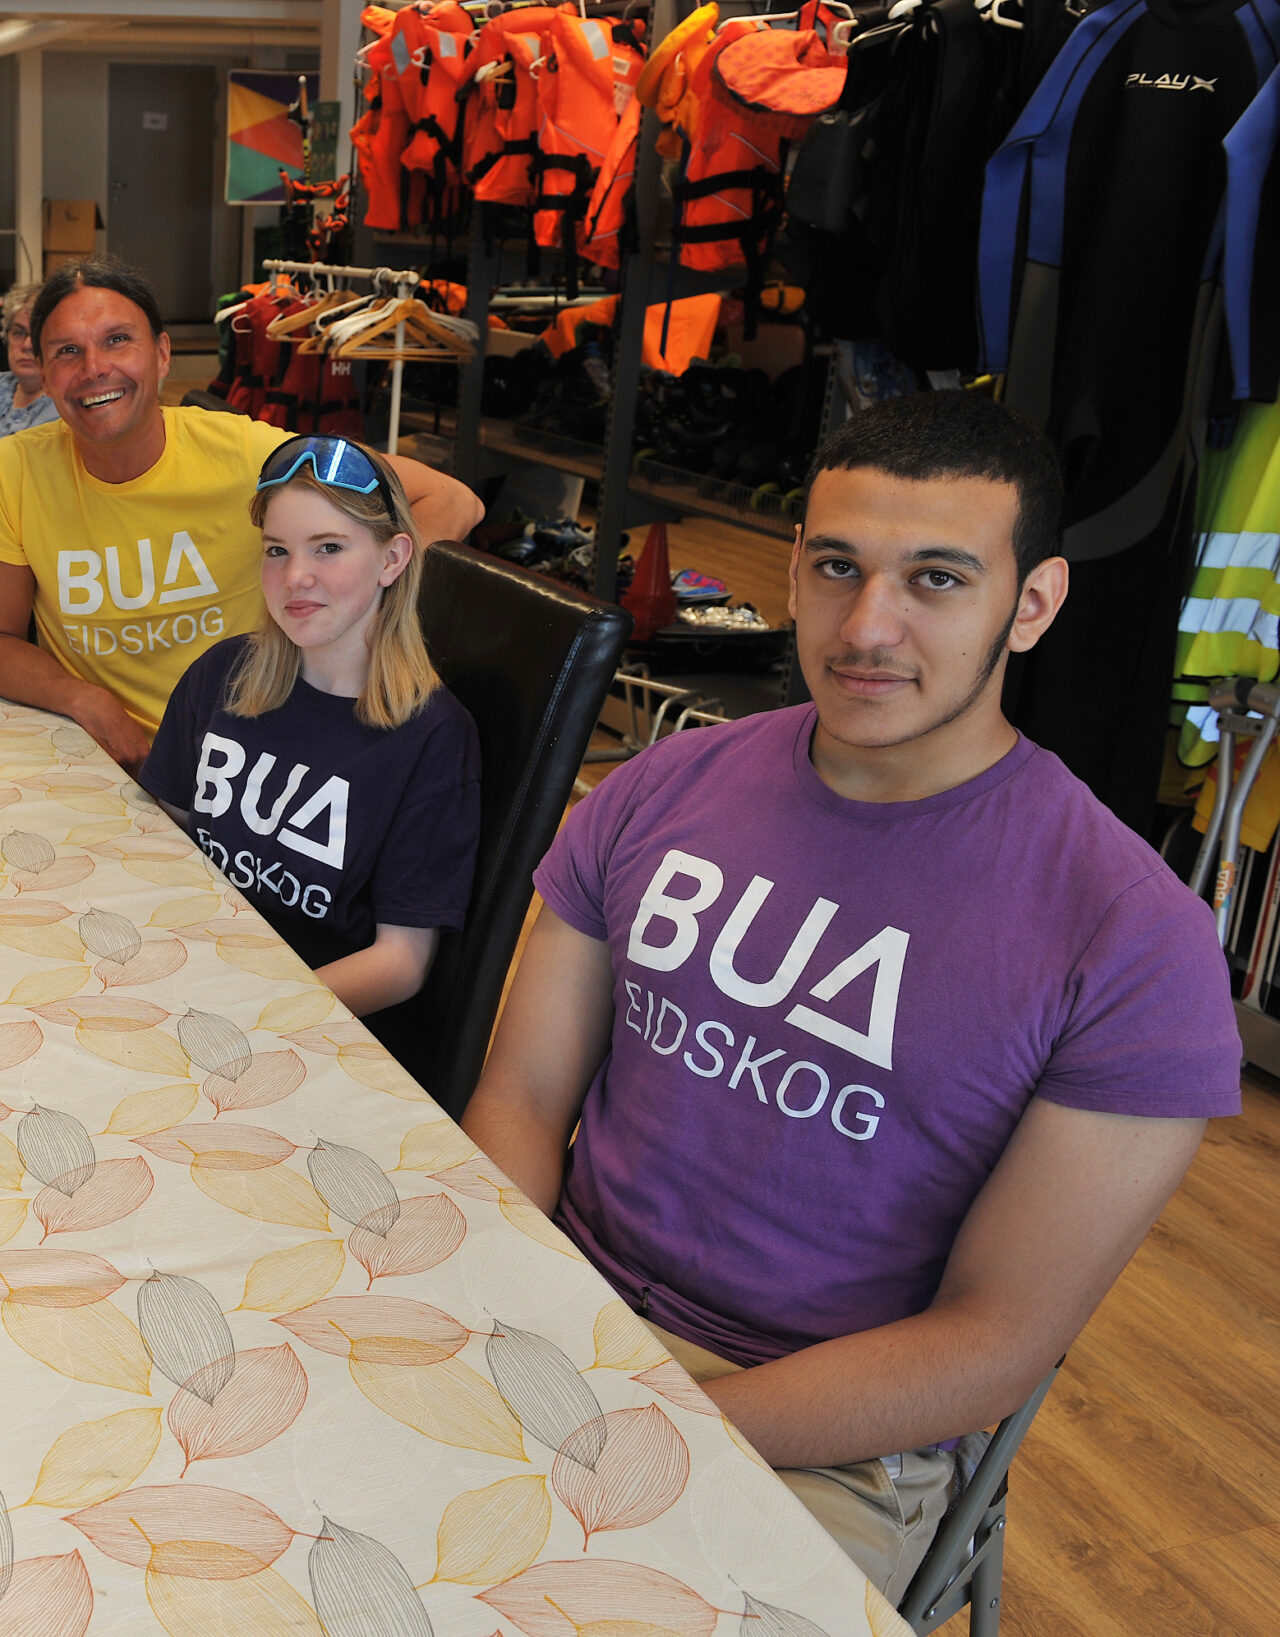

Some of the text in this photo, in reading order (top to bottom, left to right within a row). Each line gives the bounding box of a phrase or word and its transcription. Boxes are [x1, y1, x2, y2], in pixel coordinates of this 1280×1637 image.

[58, 531, 219, 615] BUA
[63, 606, 224, 655] EIDSKOG
[194, 732, 349, 870] BUA
[627, 849, 910, 1071] BUA
[625, 979, 885, 1140] EIDSKOG
